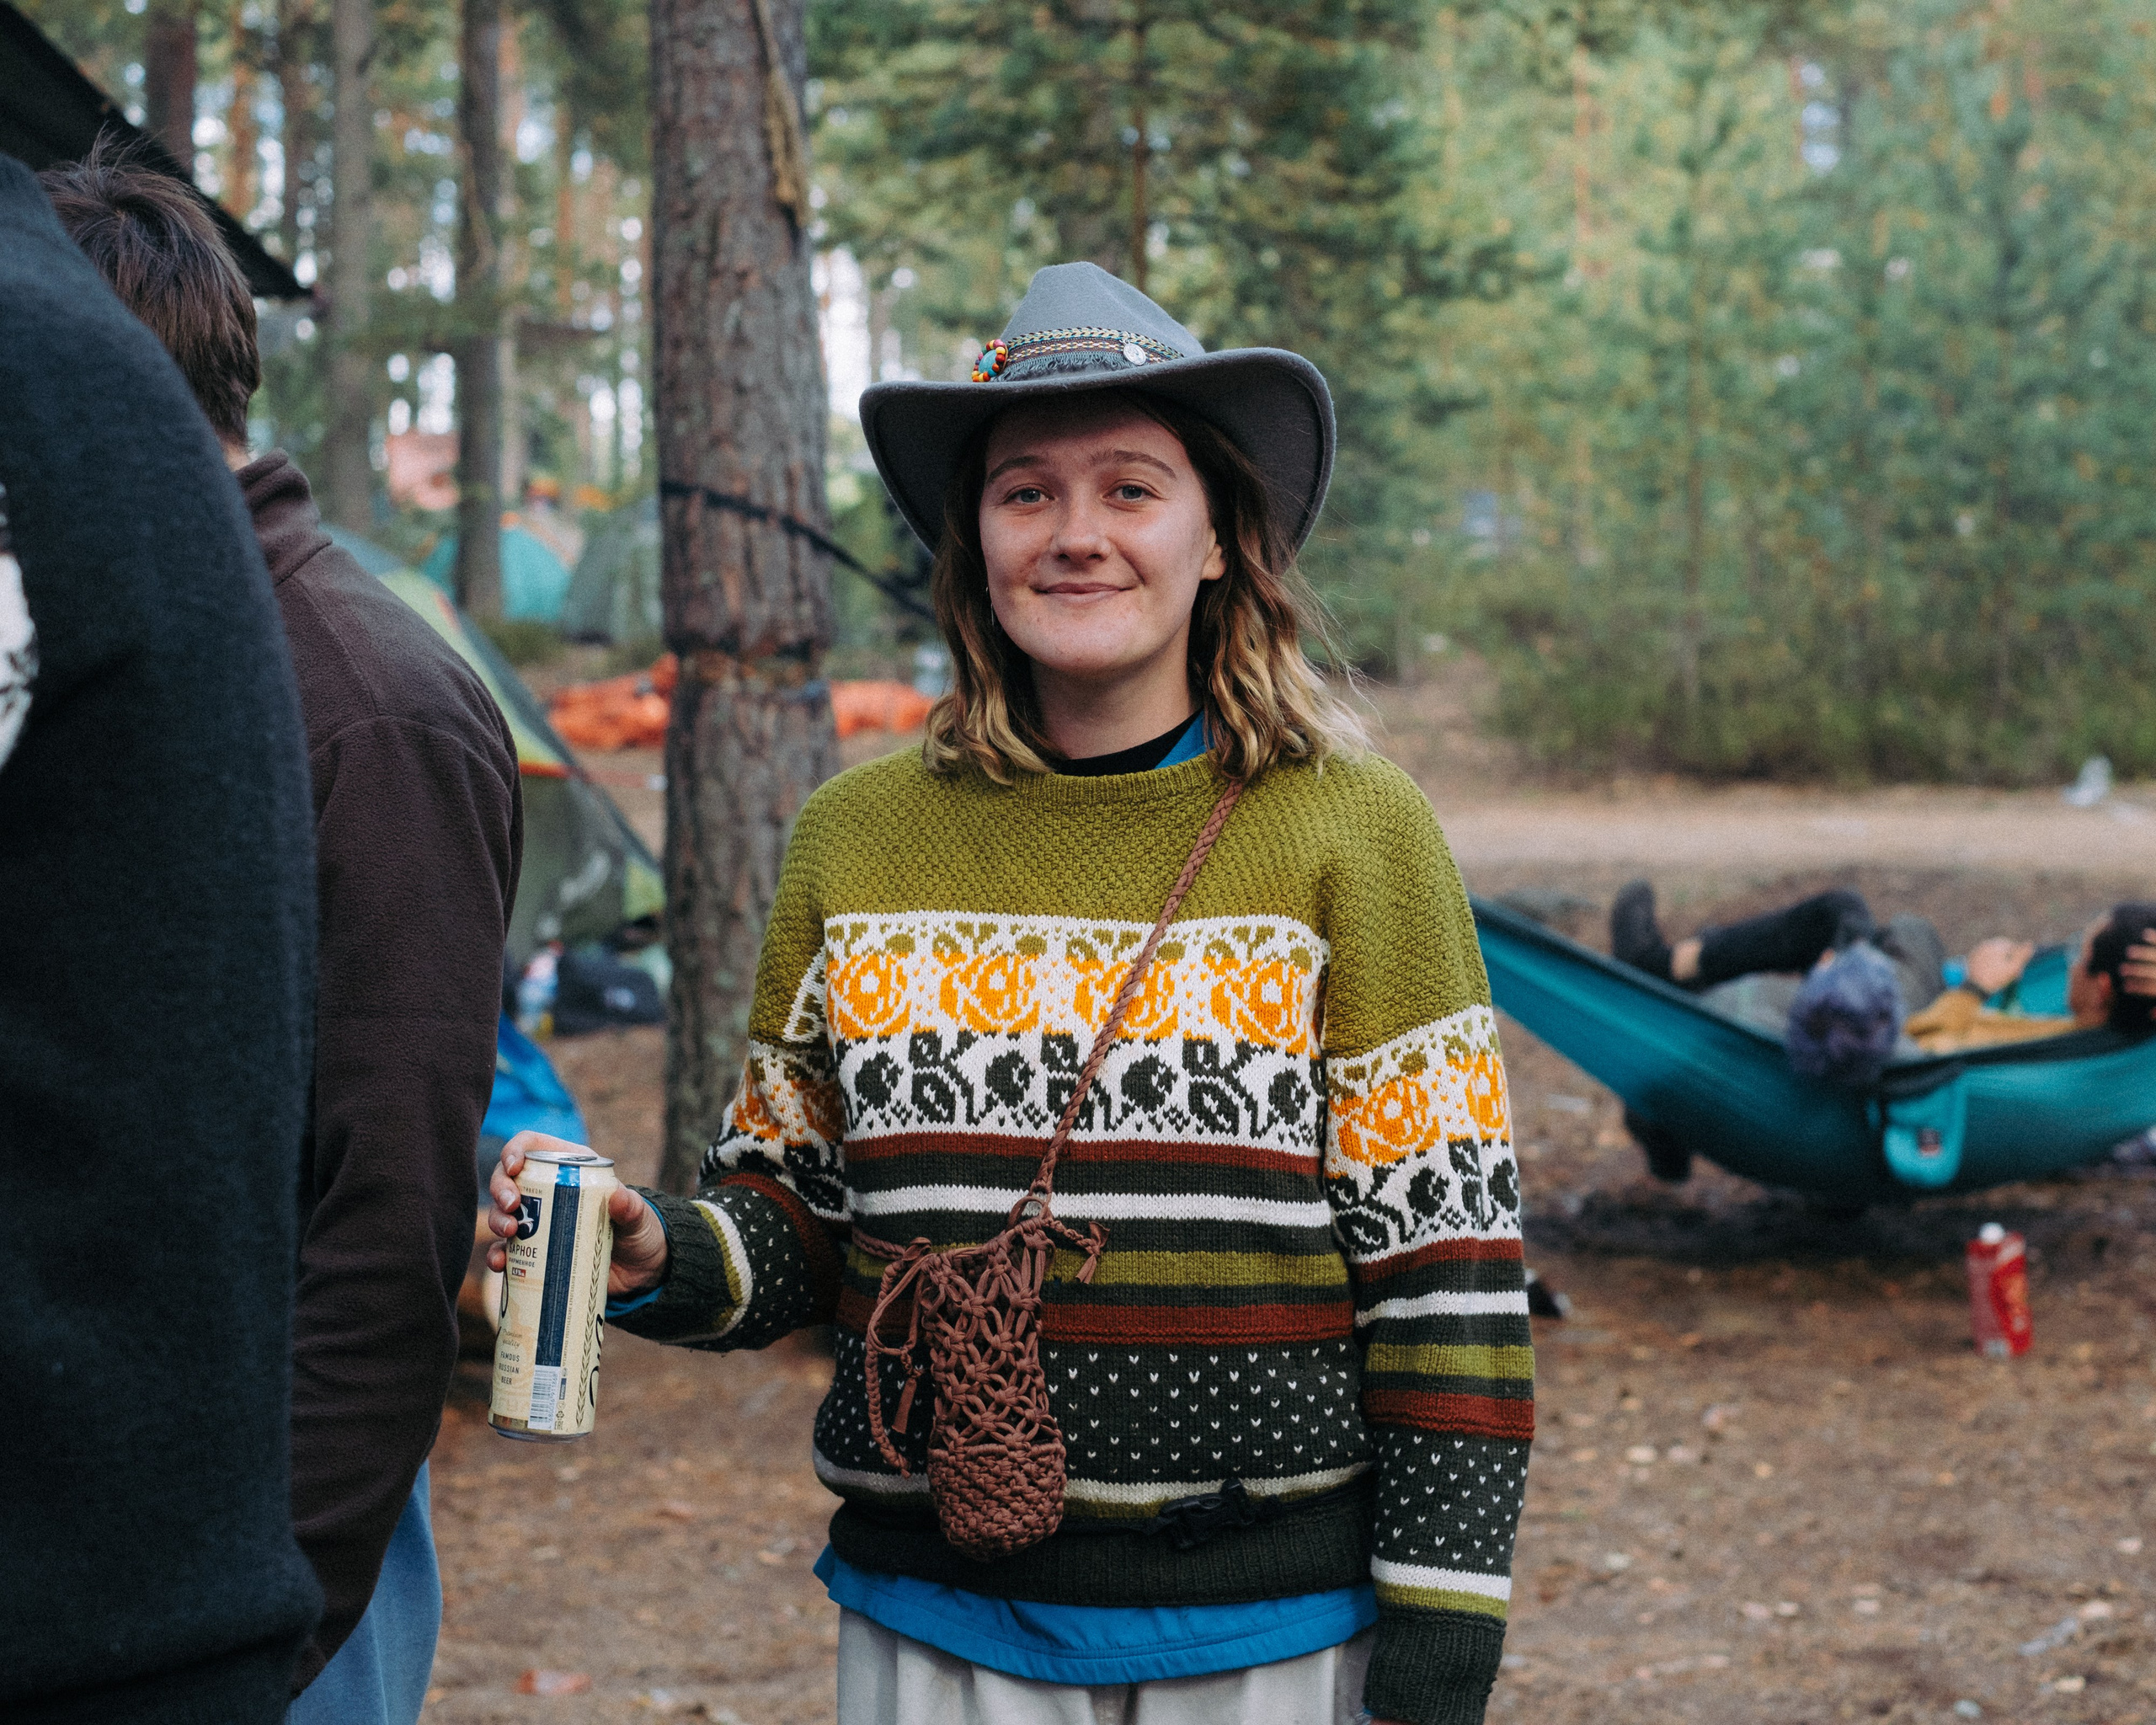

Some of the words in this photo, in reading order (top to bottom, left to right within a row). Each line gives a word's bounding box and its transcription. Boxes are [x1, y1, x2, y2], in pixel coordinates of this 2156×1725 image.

[500, 1351, 520, 1363] FAMOUS
[499, 1363, 520, 1375] RUSSIAN
[501, 1375, 512, 1386] BEER
